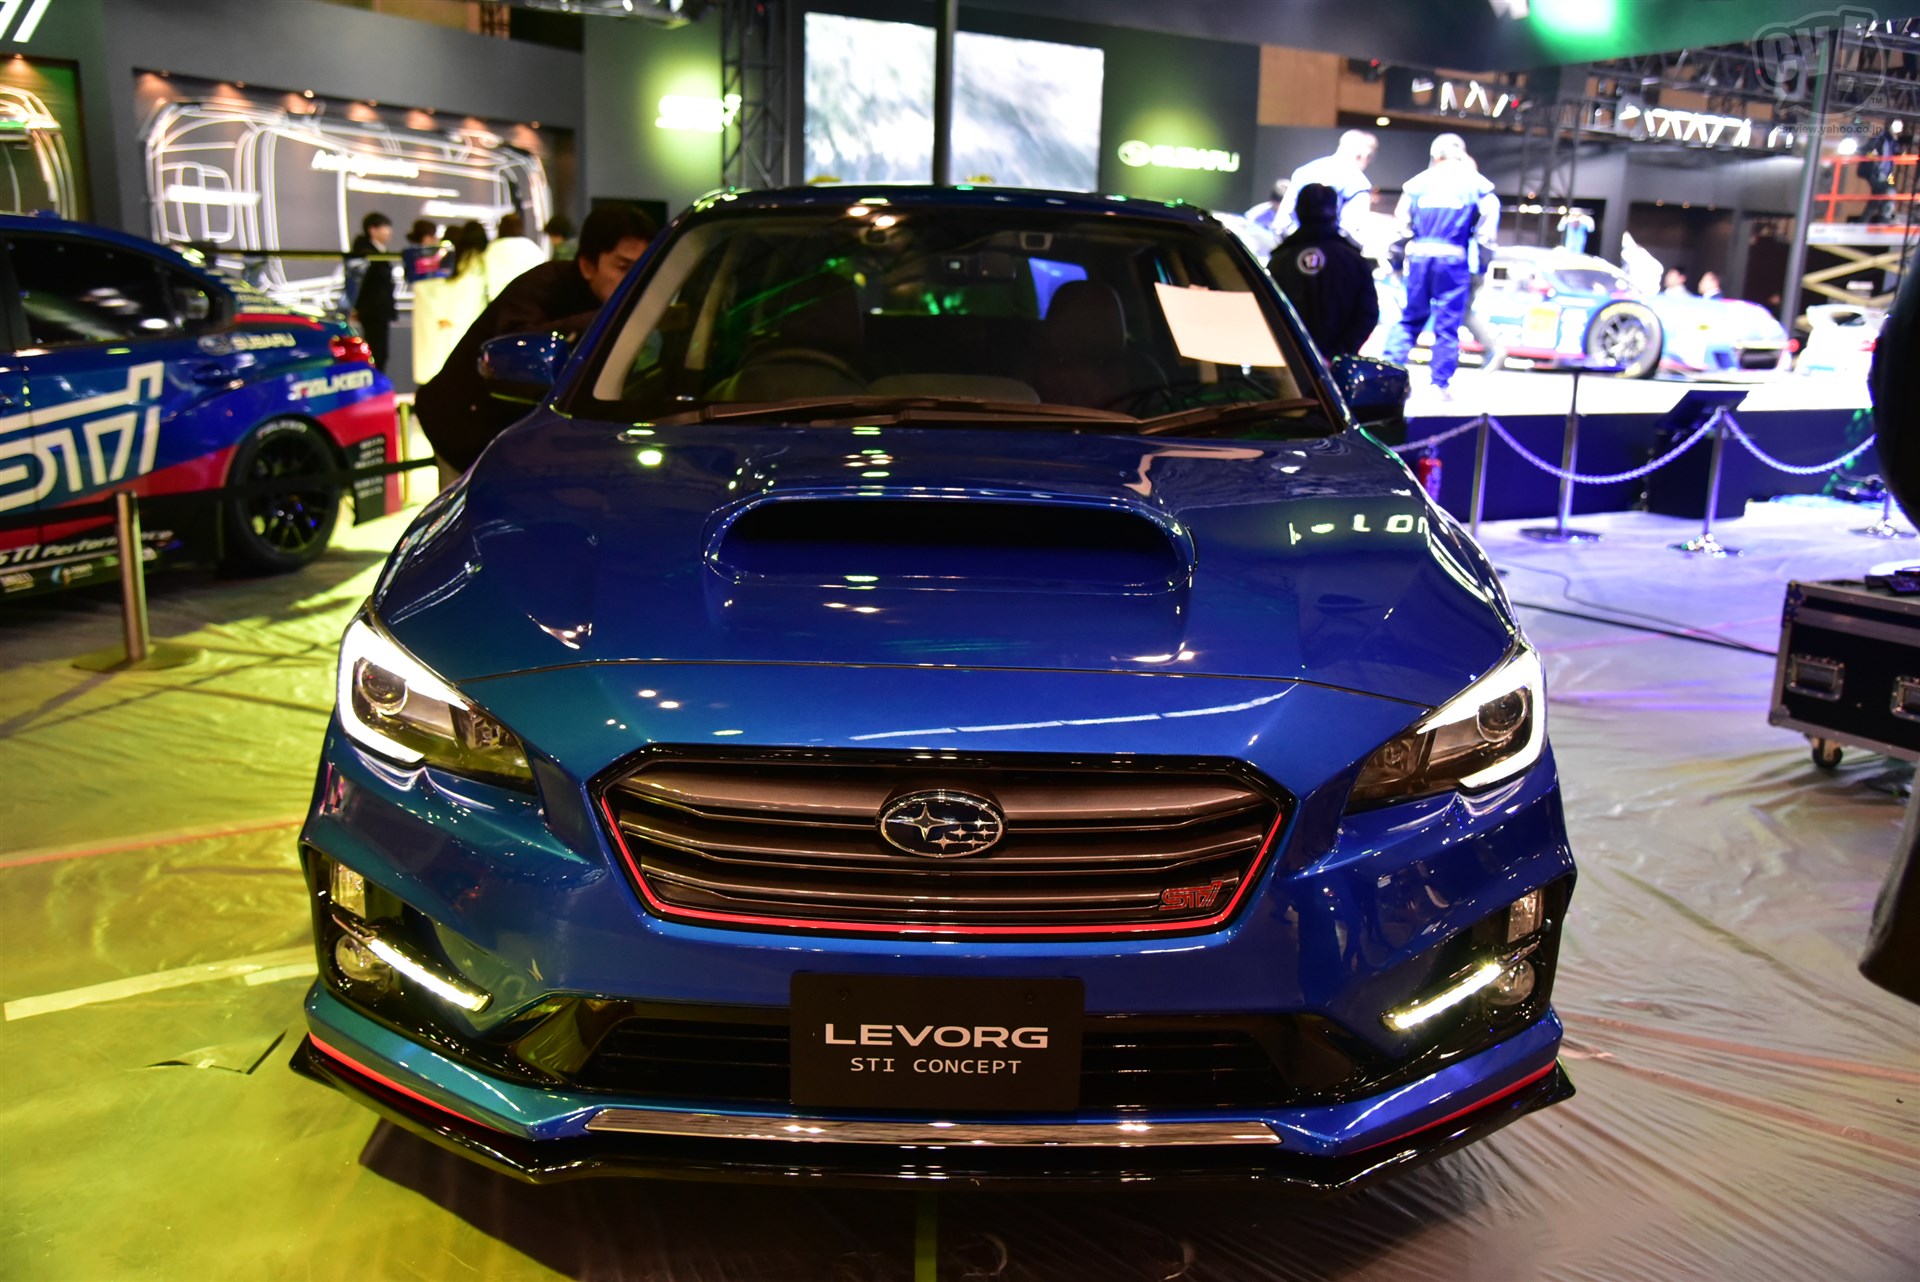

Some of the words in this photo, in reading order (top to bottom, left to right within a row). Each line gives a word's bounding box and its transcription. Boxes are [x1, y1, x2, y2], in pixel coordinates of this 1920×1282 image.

[231, 333, 297, 351] SUBARU
[287, 369, 374, 401] FALKEN
[825, 1023, 1049, 1049] LEVORG
[850, 1057, 895, 1072] STI
[913, 1058, 1022, 1074] CONCEPT
